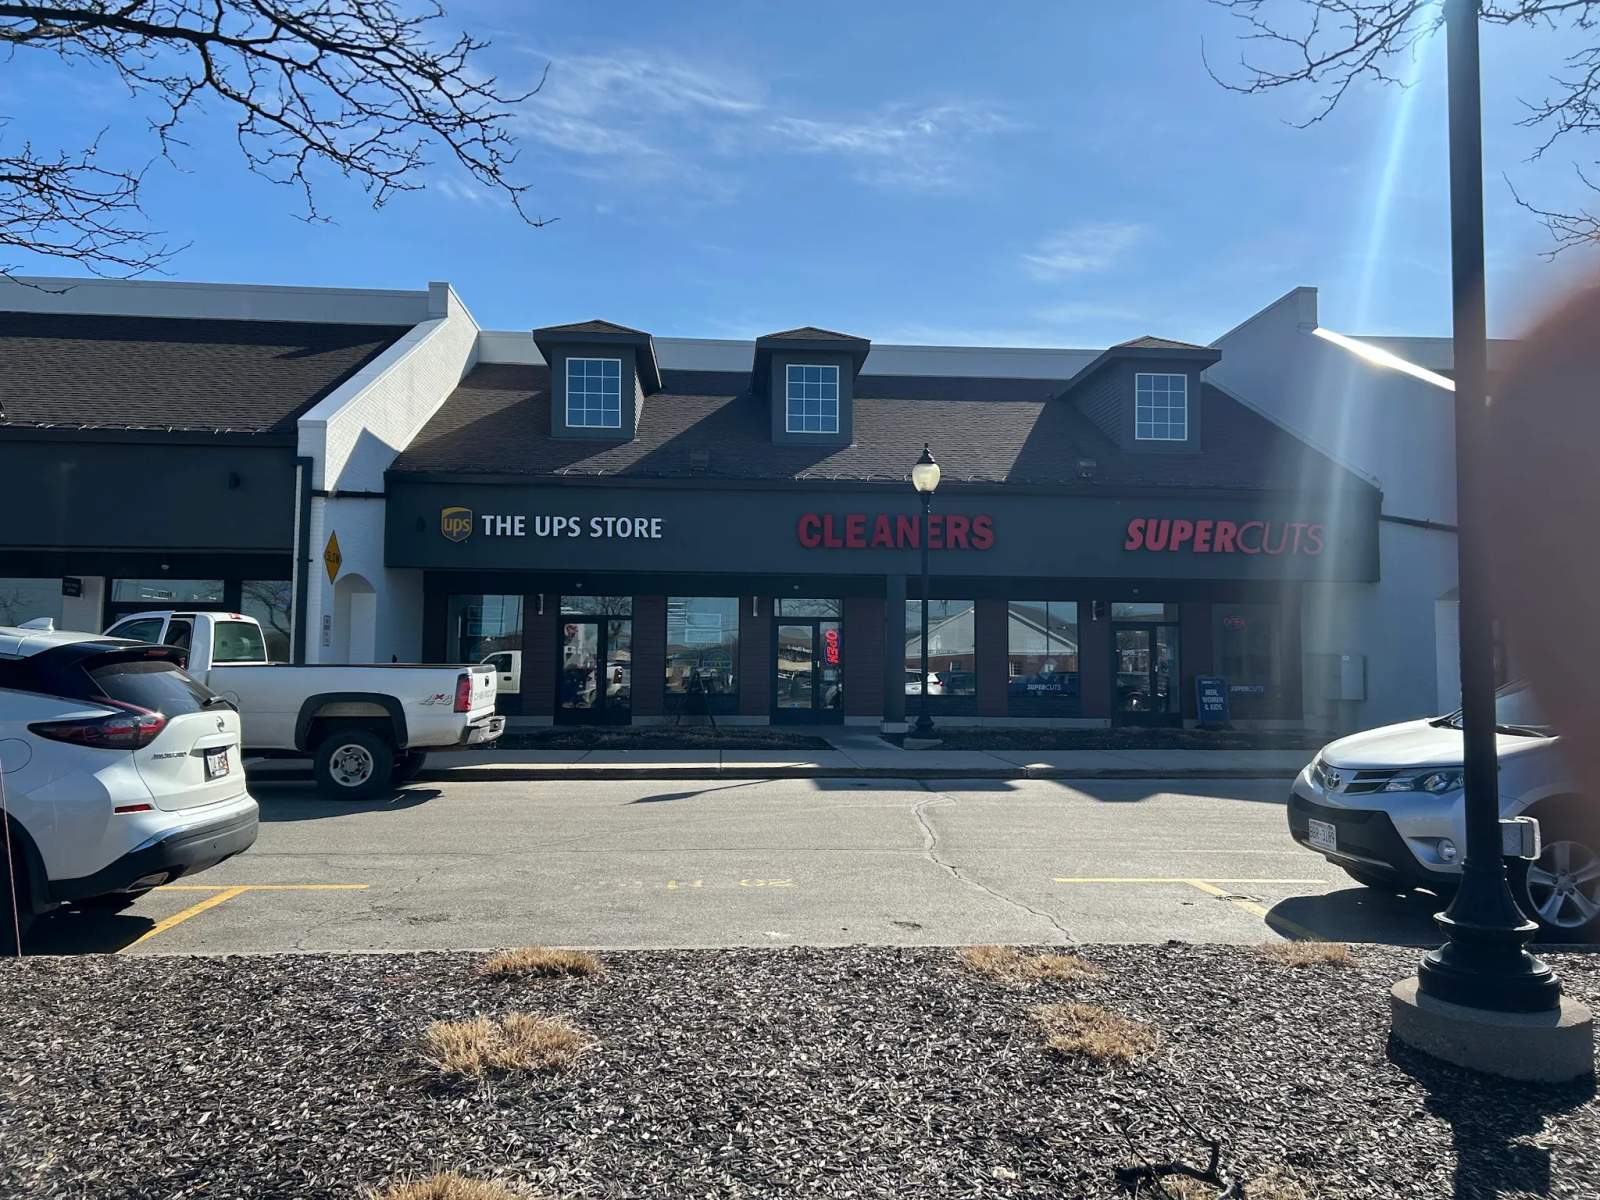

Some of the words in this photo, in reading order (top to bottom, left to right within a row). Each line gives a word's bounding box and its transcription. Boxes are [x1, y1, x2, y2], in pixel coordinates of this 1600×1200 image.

[481, 515, 526, 537] THE
[535, 516, 581, 538] UPS
[589, 517, 662, 539] STORE
[797, 512, 995, 551] CLEANERS
[1124, 518, 1326, 555] SUPERCUTS
[825, 630, 839, 665] OPEN
